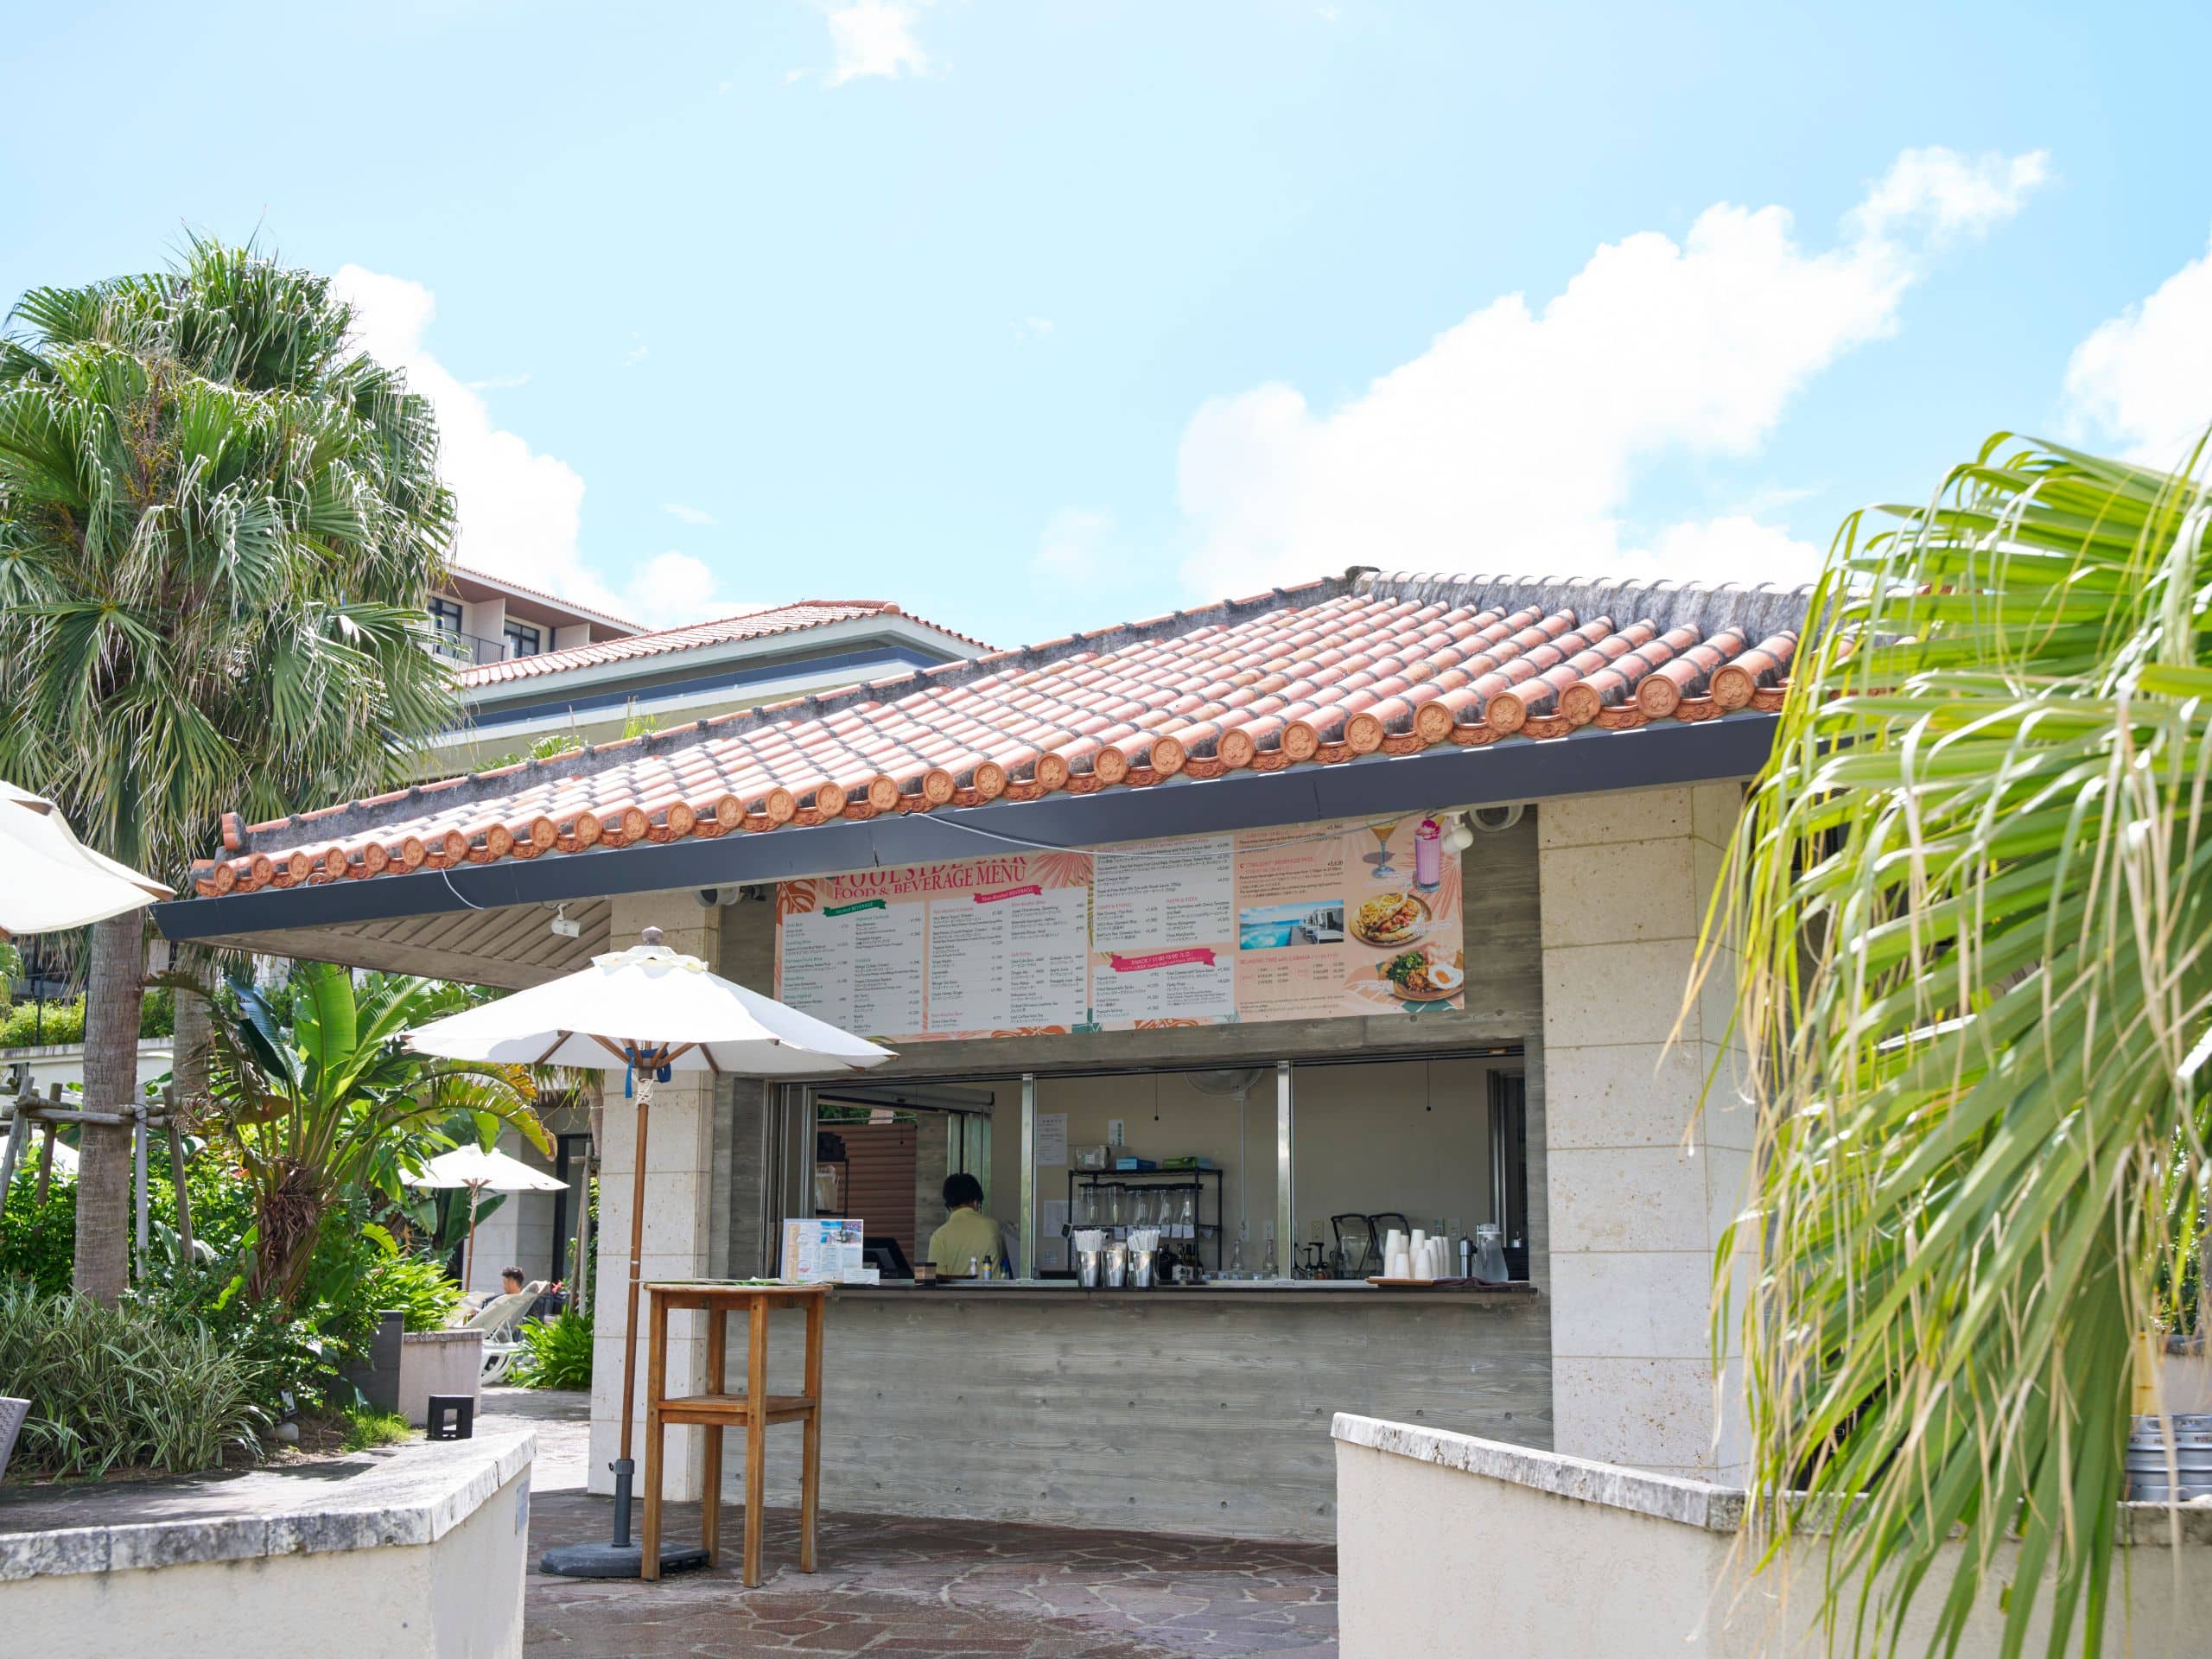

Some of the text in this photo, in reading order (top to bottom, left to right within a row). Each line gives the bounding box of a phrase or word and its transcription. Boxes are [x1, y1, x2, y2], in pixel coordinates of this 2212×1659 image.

[835, 887, 875, 899] FOOD
[894, 868, 973, 894] BEVERAGE
[976, 864, 1026, 886] MENU
